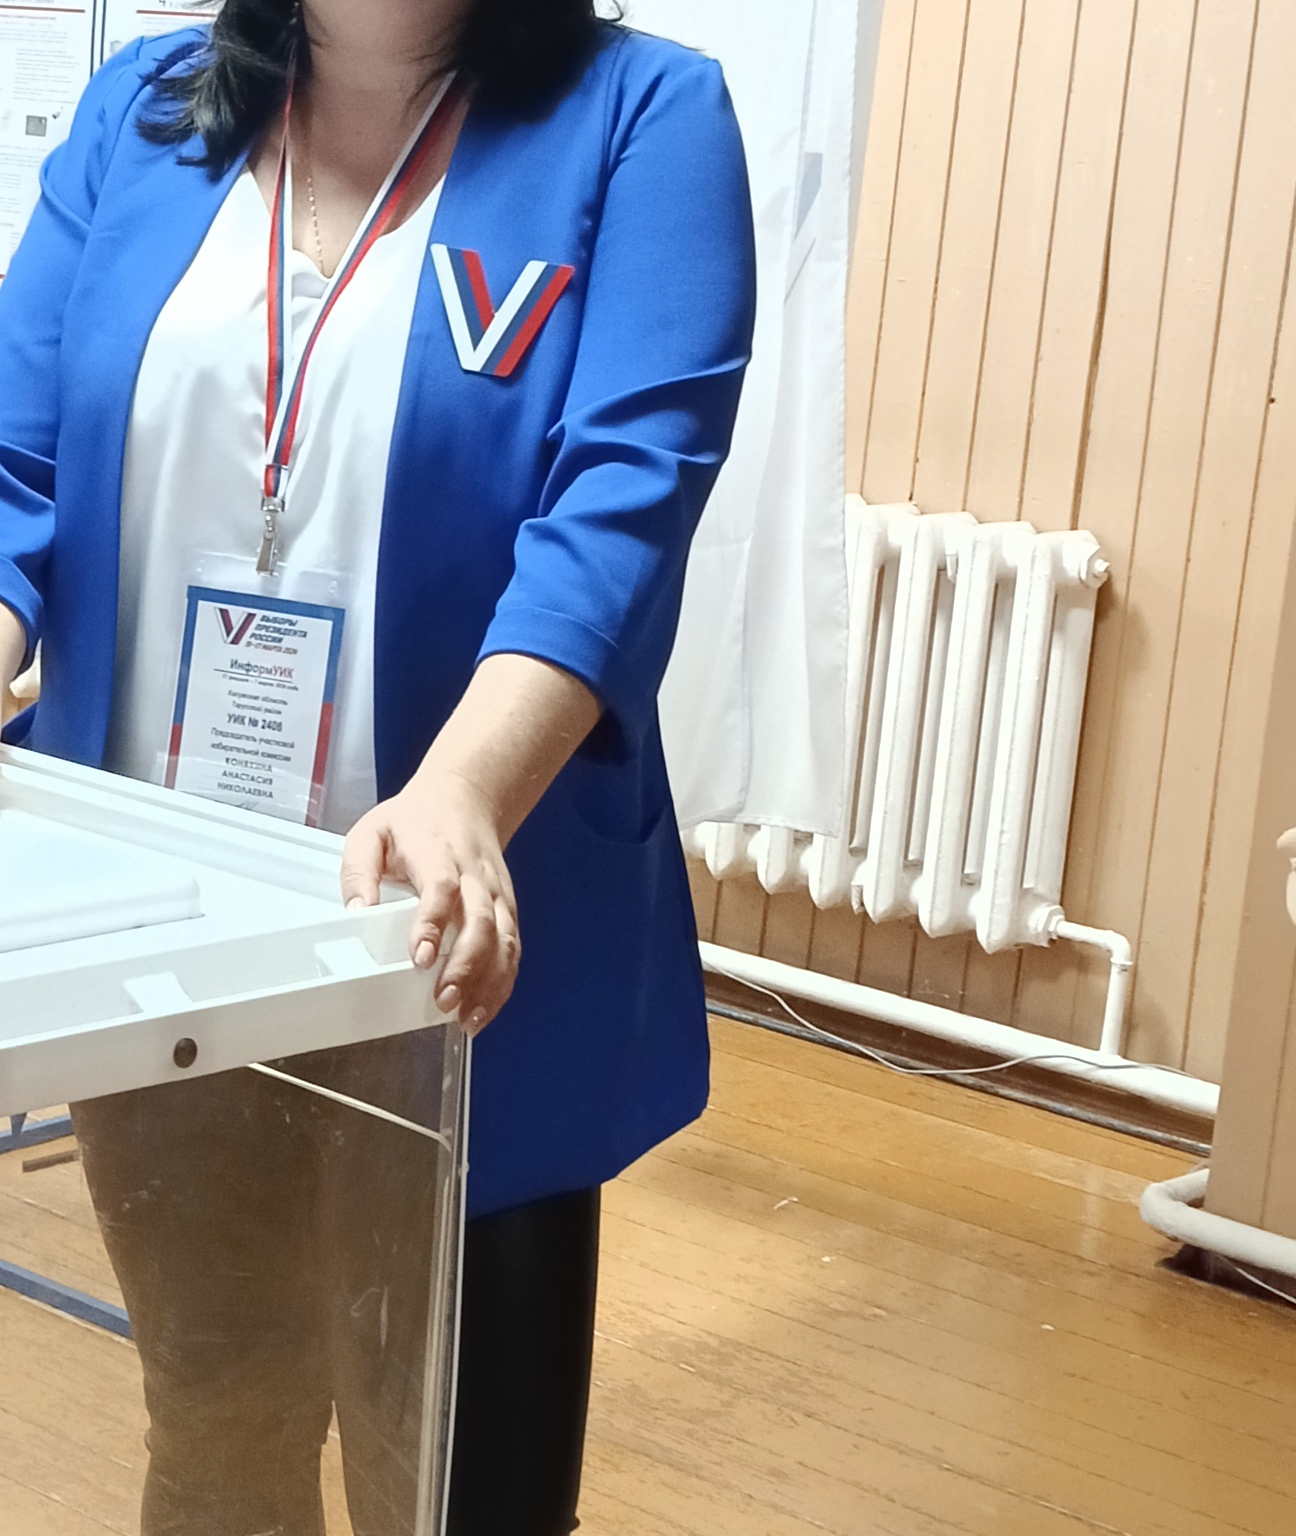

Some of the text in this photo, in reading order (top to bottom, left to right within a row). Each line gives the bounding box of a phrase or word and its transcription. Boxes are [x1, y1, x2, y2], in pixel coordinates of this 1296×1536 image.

[260, 614, 298, 627] ВЫБОРЫ
[249, 632, 284, 644] РОССИИ
[254, 624, 308, 639] ПРЕЗИДЕНТА
[229, 658, 295, 679] ИнформУИК
[227, 712, 246, 726] УИК
[221, 770, 273, 786] АНАСТАСИЯ
[217, 781, 274, 799] НИКОЛАЕВНА
